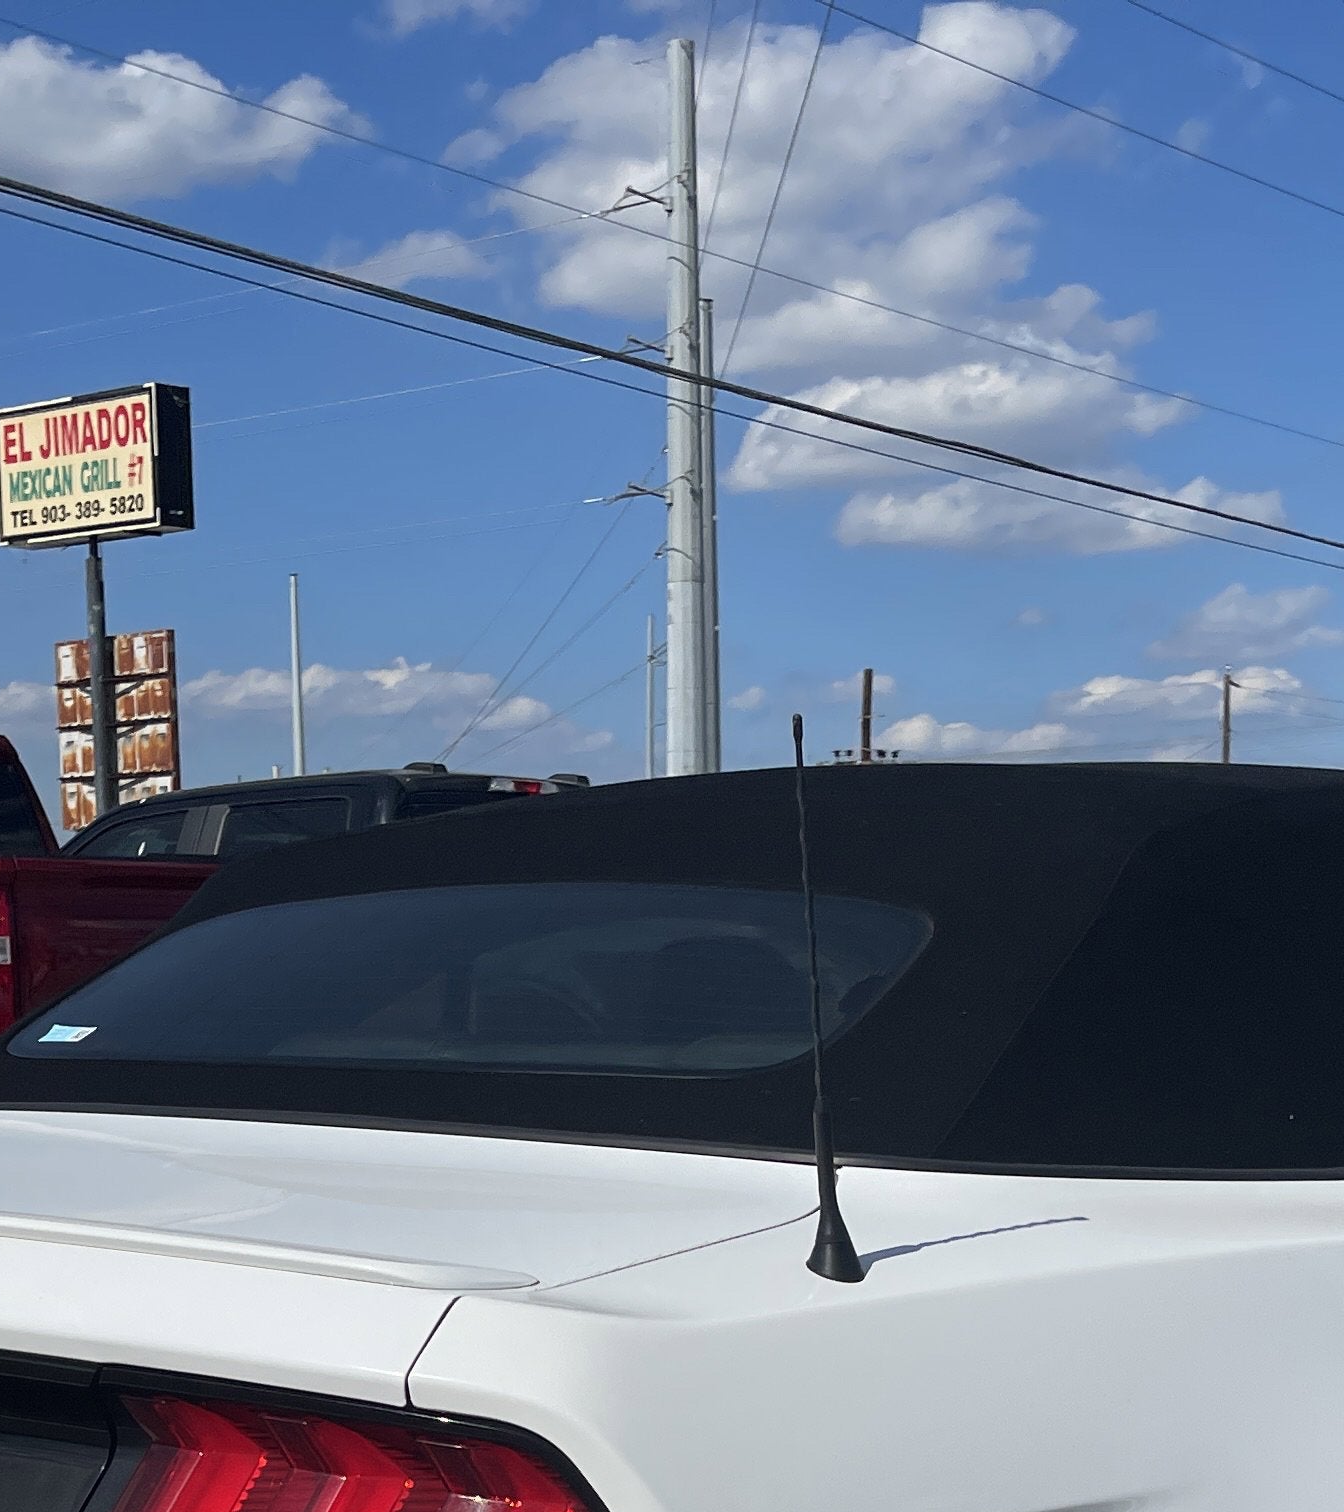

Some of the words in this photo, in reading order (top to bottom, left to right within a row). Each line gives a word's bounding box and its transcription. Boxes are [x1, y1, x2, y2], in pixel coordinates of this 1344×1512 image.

[3, 422, 33, 464] EL
[39, 402, 148, 459] JIMADOR
[9, 464, 73, 503] MEXICAN
[80, 457, 122, 493] GRILL
[11, 510, 37, 528] TEL
[110, 493, 144, 516] 5820
